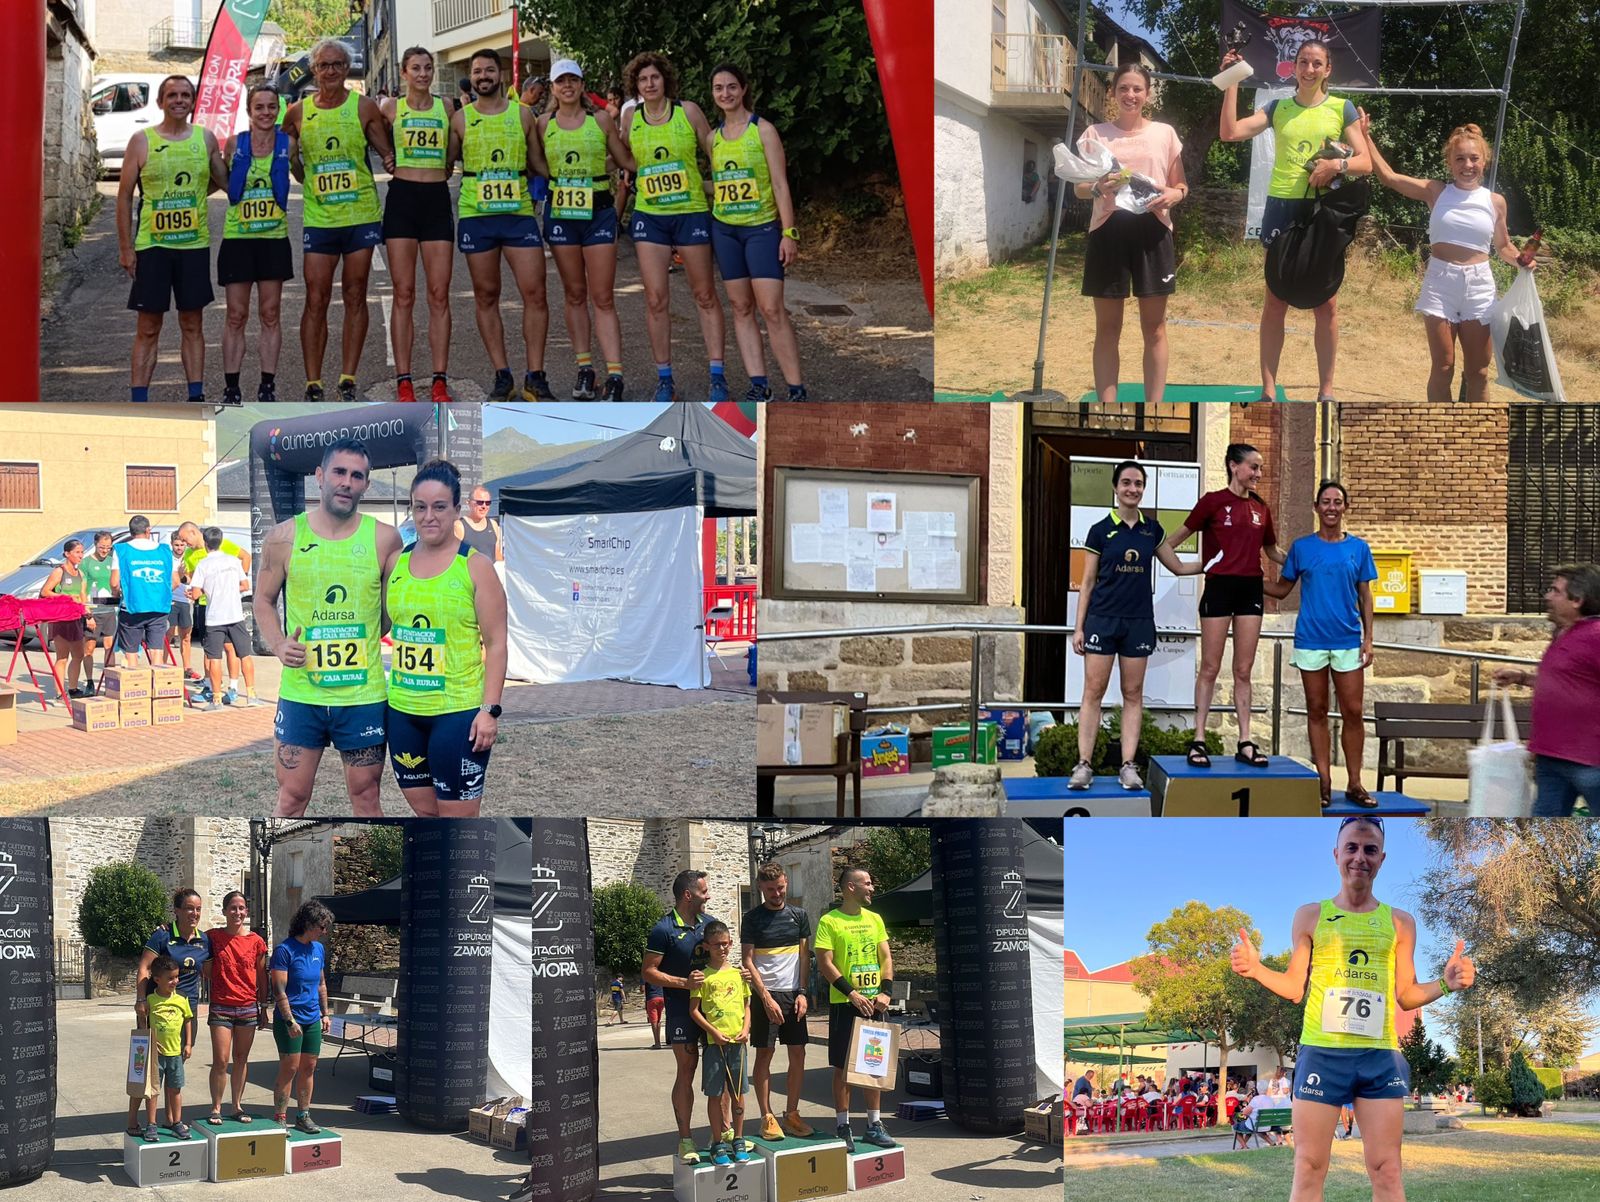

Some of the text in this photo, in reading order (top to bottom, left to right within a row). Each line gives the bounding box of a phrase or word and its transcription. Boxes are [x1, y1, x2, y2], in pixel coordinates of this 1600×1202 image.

[213, 58, 245, 138] ZAMORA
[405, 130, 439, 148] 784
[318, 173, 351, 192] 0175
[645, 173, 682, 195] 0199
[163, 190, 196, 199] Adarsa
[483, 183, 513, 200] 814
[556, 190, 586, 207] 813
[718, 182, 753, 202] 782
[243, 200, 276, 219] 0197
[155, 211, 192, 231] 0195
[281, 429, 338, 451] alimentos
[352, 418, 405, 441] zamora
[1073, 464, 1103, 475] Deporte
[588, 537, 631, 551] SmartChip
[1115, 564, 1144, 573] Adarsa
[311, 609, 356, 621] Adarsa
[312, 642, 358, 668] 152
[396, 644, 435, 672] 154
[323, 673, 364, 682] CAJA RURAL
[1231, 787, 1250, 818] 1
[555, 838, 576, 847] ZAMORA
[856, 972, 877, 987] 166
[1334, 967, 1378, 981] Adarsa
[565, 994, 585, 1002] ZAMORA
[1339, 996, 1371, 1018] 76
[569, 1046, 588, 1055] ZAMORA
[1299, 1085, 1324, 1097] Adarsa
[572, 1098, 590, 1107] ZAMORA
[248, 1140, 256, 1156] 1
[311, 1145, 321, 1158] 3
[169, 1151, 181, 1166] 2
[303, 1158, 331, 1168] SmartChip
[808, 1157, 816, 1173] 1
[874, 1157, 884, 1171] 3
[159, 1170, 191, 1180] SmartChip
[237, 1166, 266, 1175] SmartChip
[867, 1172, 894, 1183] SmartChip
[726, 1173, 738, 1191] 2
[798, 1185, 829, 1196] SmartChip
